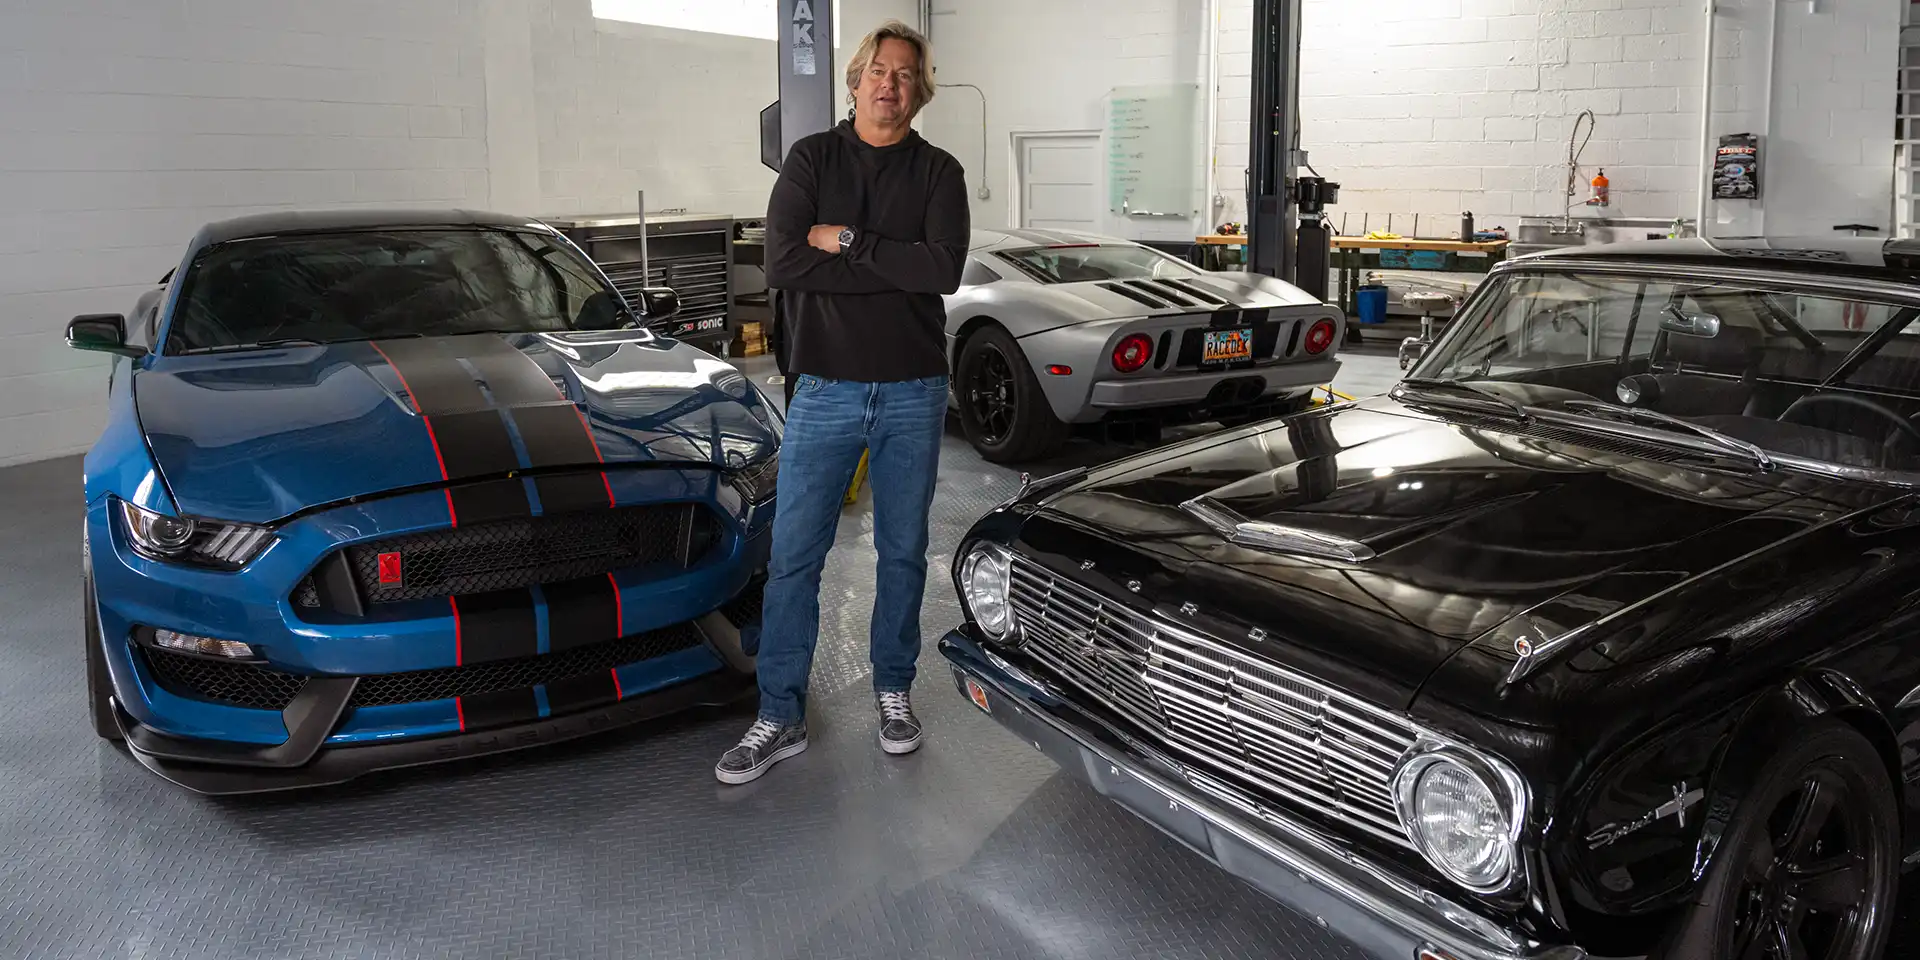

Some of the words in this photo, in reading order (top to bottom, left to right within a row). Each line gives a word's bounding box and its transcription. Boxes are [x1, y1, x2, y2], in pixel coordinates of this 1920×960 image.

[698, 317, 723, 330] SONIC
[1207, 338, 1248, 356] RACEDEK
[1080, 559, 1268, 642] FORD
[1585, 811, 1653, 850] Sprint
